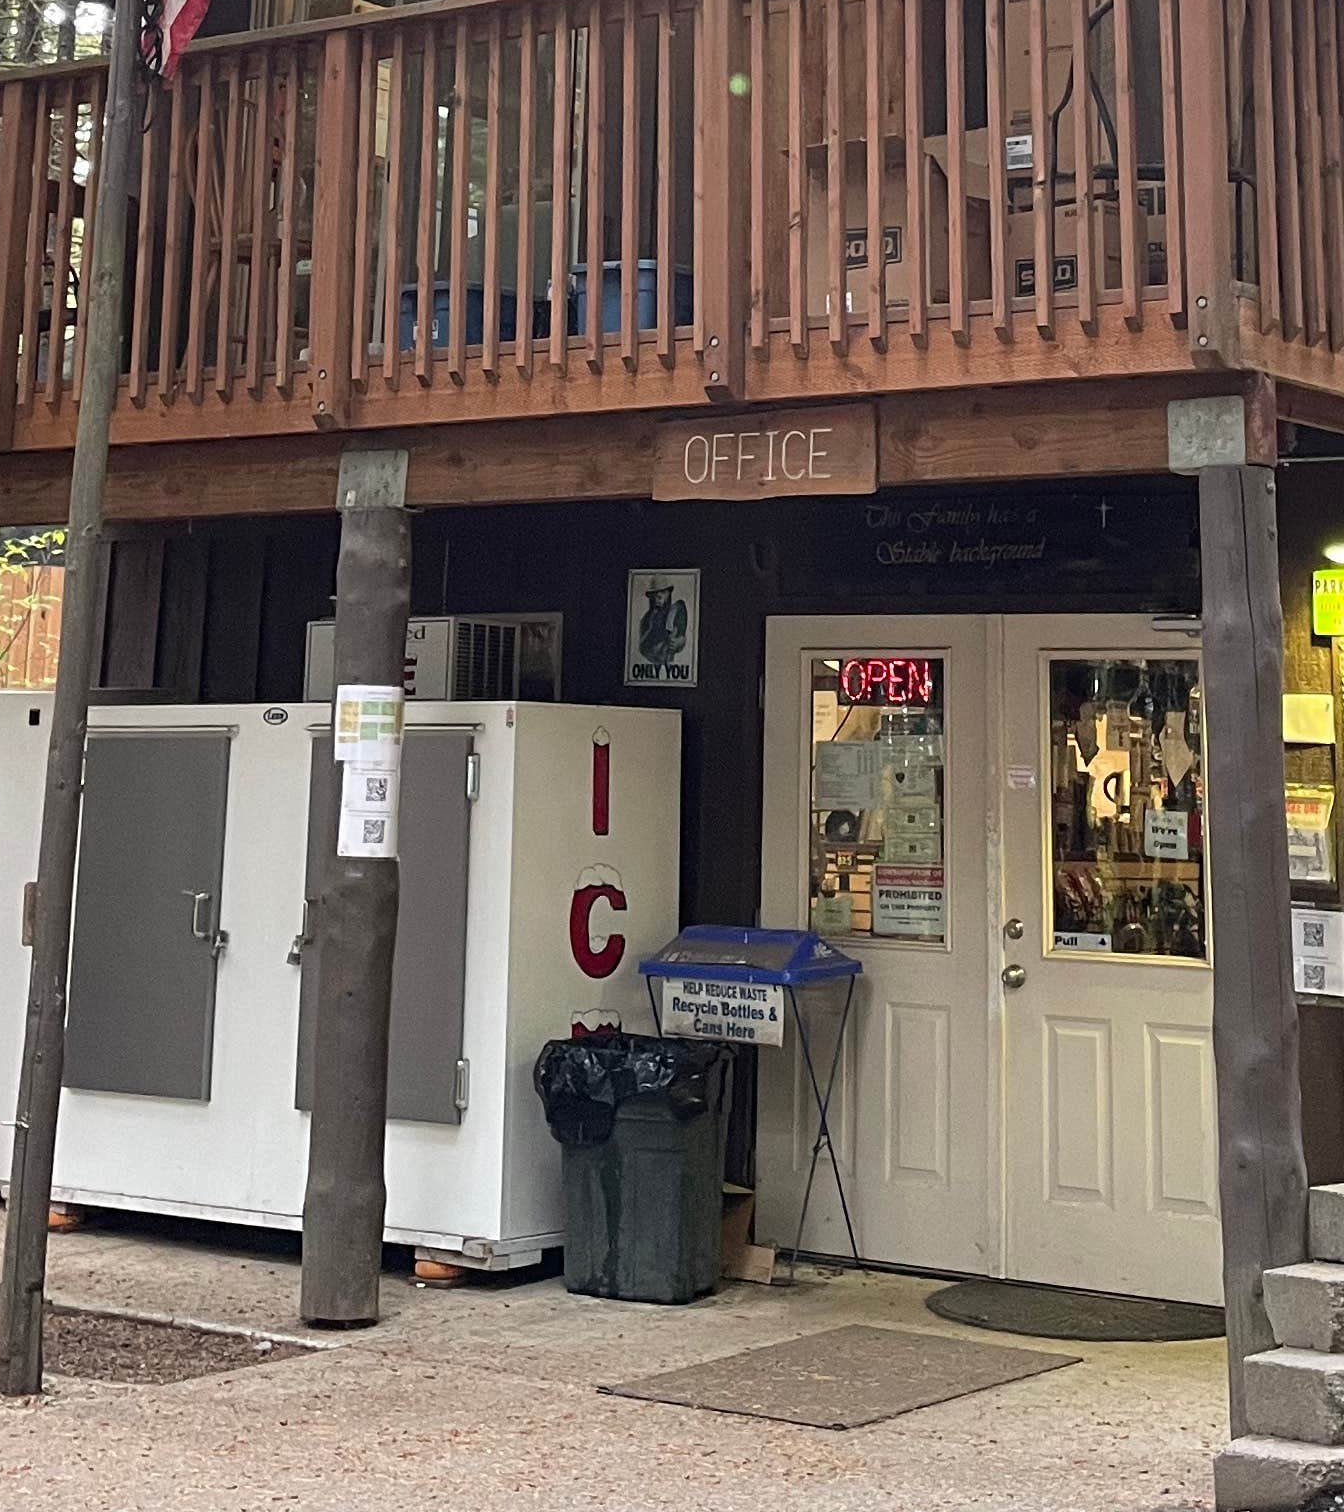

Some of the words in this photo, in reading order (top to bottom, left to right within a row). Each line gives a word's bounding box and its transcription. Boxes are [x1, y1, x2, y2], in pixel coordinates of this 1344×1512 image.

[684, 428, 833, 484] OFFICE
[949, 537, 1047, 570] background
[1315, 579, 1344, 595] PARK
[631, 663, 661, 679] ONLY
[664, 663, 690, 680] YOU
[842, 659, 931, 703] OPEN
[878, 889, 943, 901] PROHIBITED
[1054, 935, 1078, 947] Pull
[682, 981, 703, 996] HELP
[705, 982, 738, 1000] REDUCE
[739, 985, 768, 1002] WASTE
[672, 996, 718, 1018] Recycle
[720, 1001, 765, 1021] Bottles
[768, 1006, 778, 1022] &
[693, 1018, 723, 1037] Cans
[726, 1021, 756, 1039] Here
